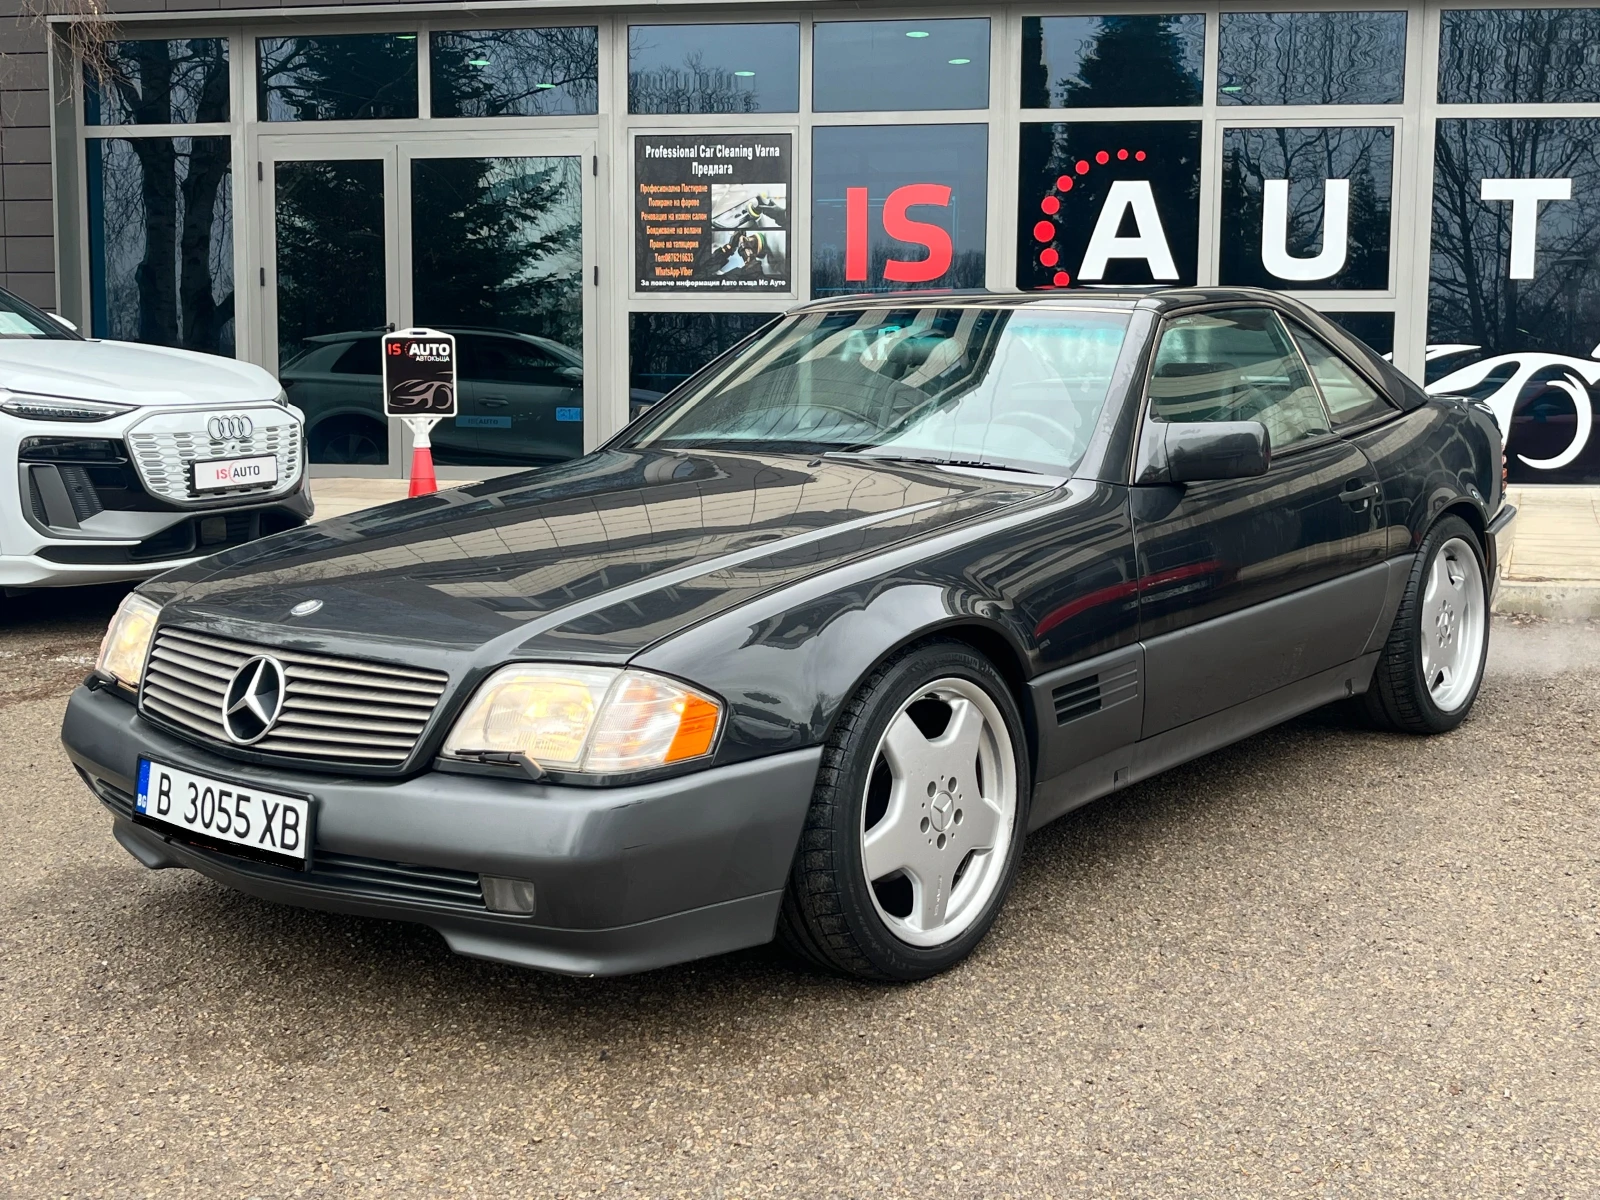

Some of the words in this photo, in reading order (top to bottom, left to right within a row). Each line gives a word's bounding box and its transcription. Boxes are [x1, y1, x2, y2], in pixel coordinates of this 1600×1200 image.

[645, 144, 698, 159] Professional
[700, 144, 715, 158] Car
[716, 144, 753, 161] Cleaning
[755, 143, 780, 158] Varna
[692, 161, 733, 178] Предлага
[846, 183, 953, 282] IS
[676, 279, 720, 287] информация
[769, 279, 786, 287] Ауто
[387, 343, 402, 356] IS
[409, 343, 450, 356] AUTO
[216, 468, 228, 480] IS
[232, 465, 260, 478] AUTO
[136, 793, 147, 809] BG
[157, 772, 172, 816] B
[183, 781, 252, 839] 3055
[258, 799, 300, 851] XB
